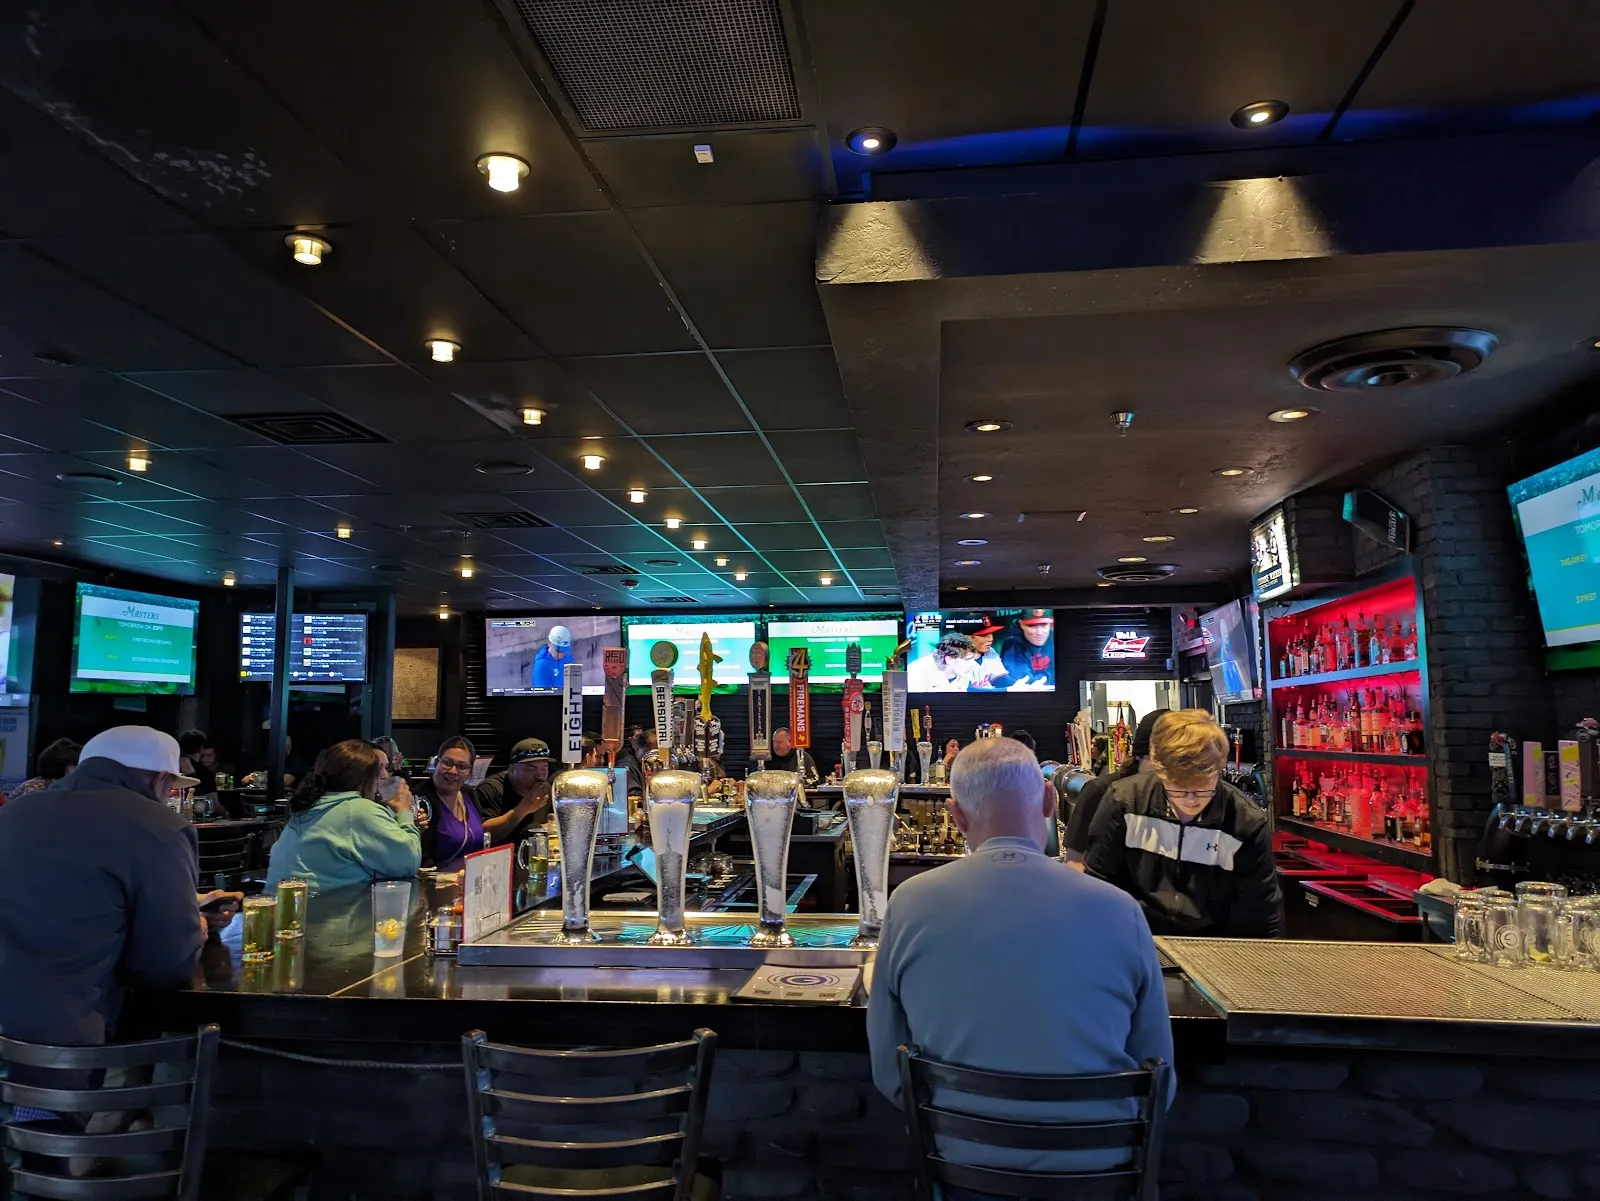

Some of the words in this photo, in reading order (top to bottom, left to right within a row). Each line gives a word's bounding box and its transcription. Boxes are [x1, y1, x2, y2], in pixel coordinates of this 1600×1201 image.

[791, 648, 809, 679] 4
[569, 687, 582, 752] EIGHT
[655, 686, 668, 745] SEASONAL
[796, 684, 806, 733] FIREMANS
[893, 692, 902, 732] REVOLVER
